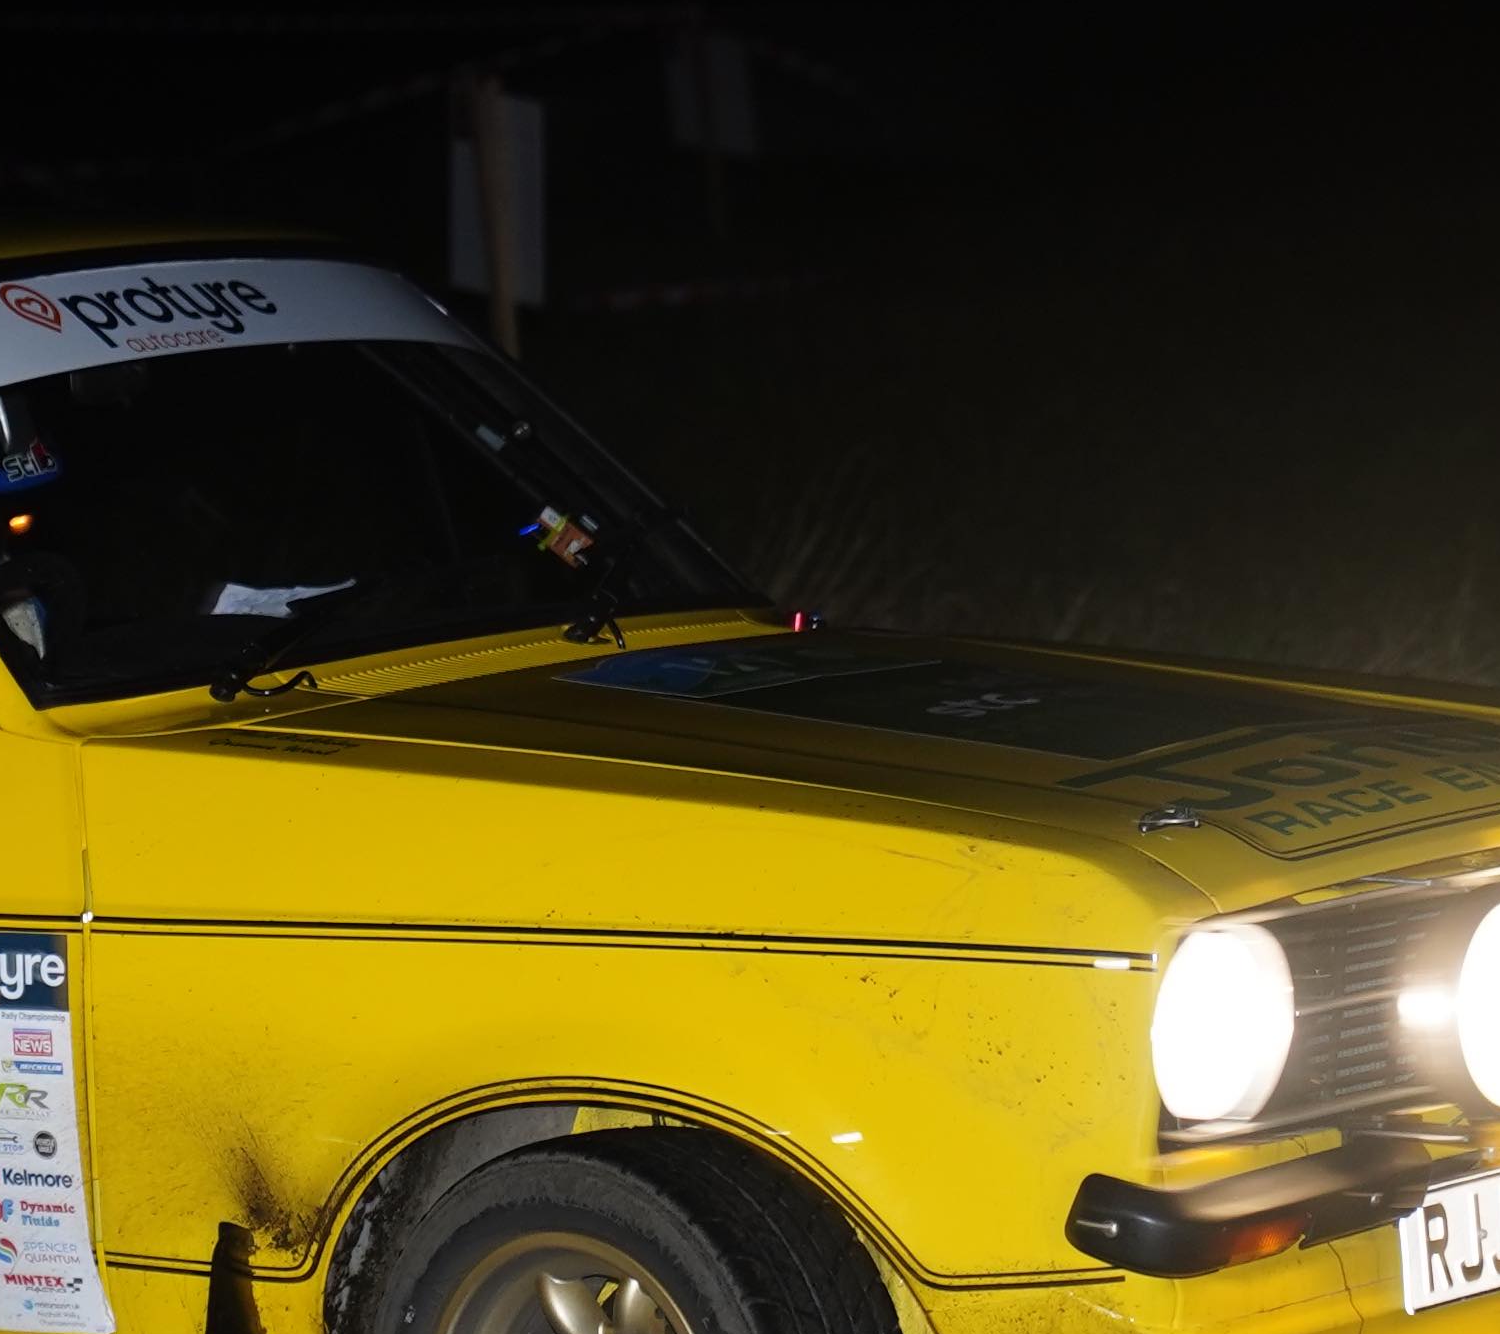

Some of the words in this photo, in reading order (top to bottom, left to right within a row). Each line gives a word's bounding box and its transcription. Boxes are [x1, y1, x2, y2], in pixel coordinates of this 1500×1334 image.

[58, 277, 277, 348] protyre
[126, 329, 225, 353] autocare
[1243, 779, 1431, 836] RACE
[14, 1039, 52, 1053] NEWS
[2, 1168, 73, 1188] Kelmore
[19, 1201, 76, 1215] Dynamic
[21, 1215, 60, 1228] Fluids
[23, 1241, 78, 1253] SPENCER
[24, 1253, 81, 1265] QUANTUM
[3, 1273, 65, 1288] MINTEX
